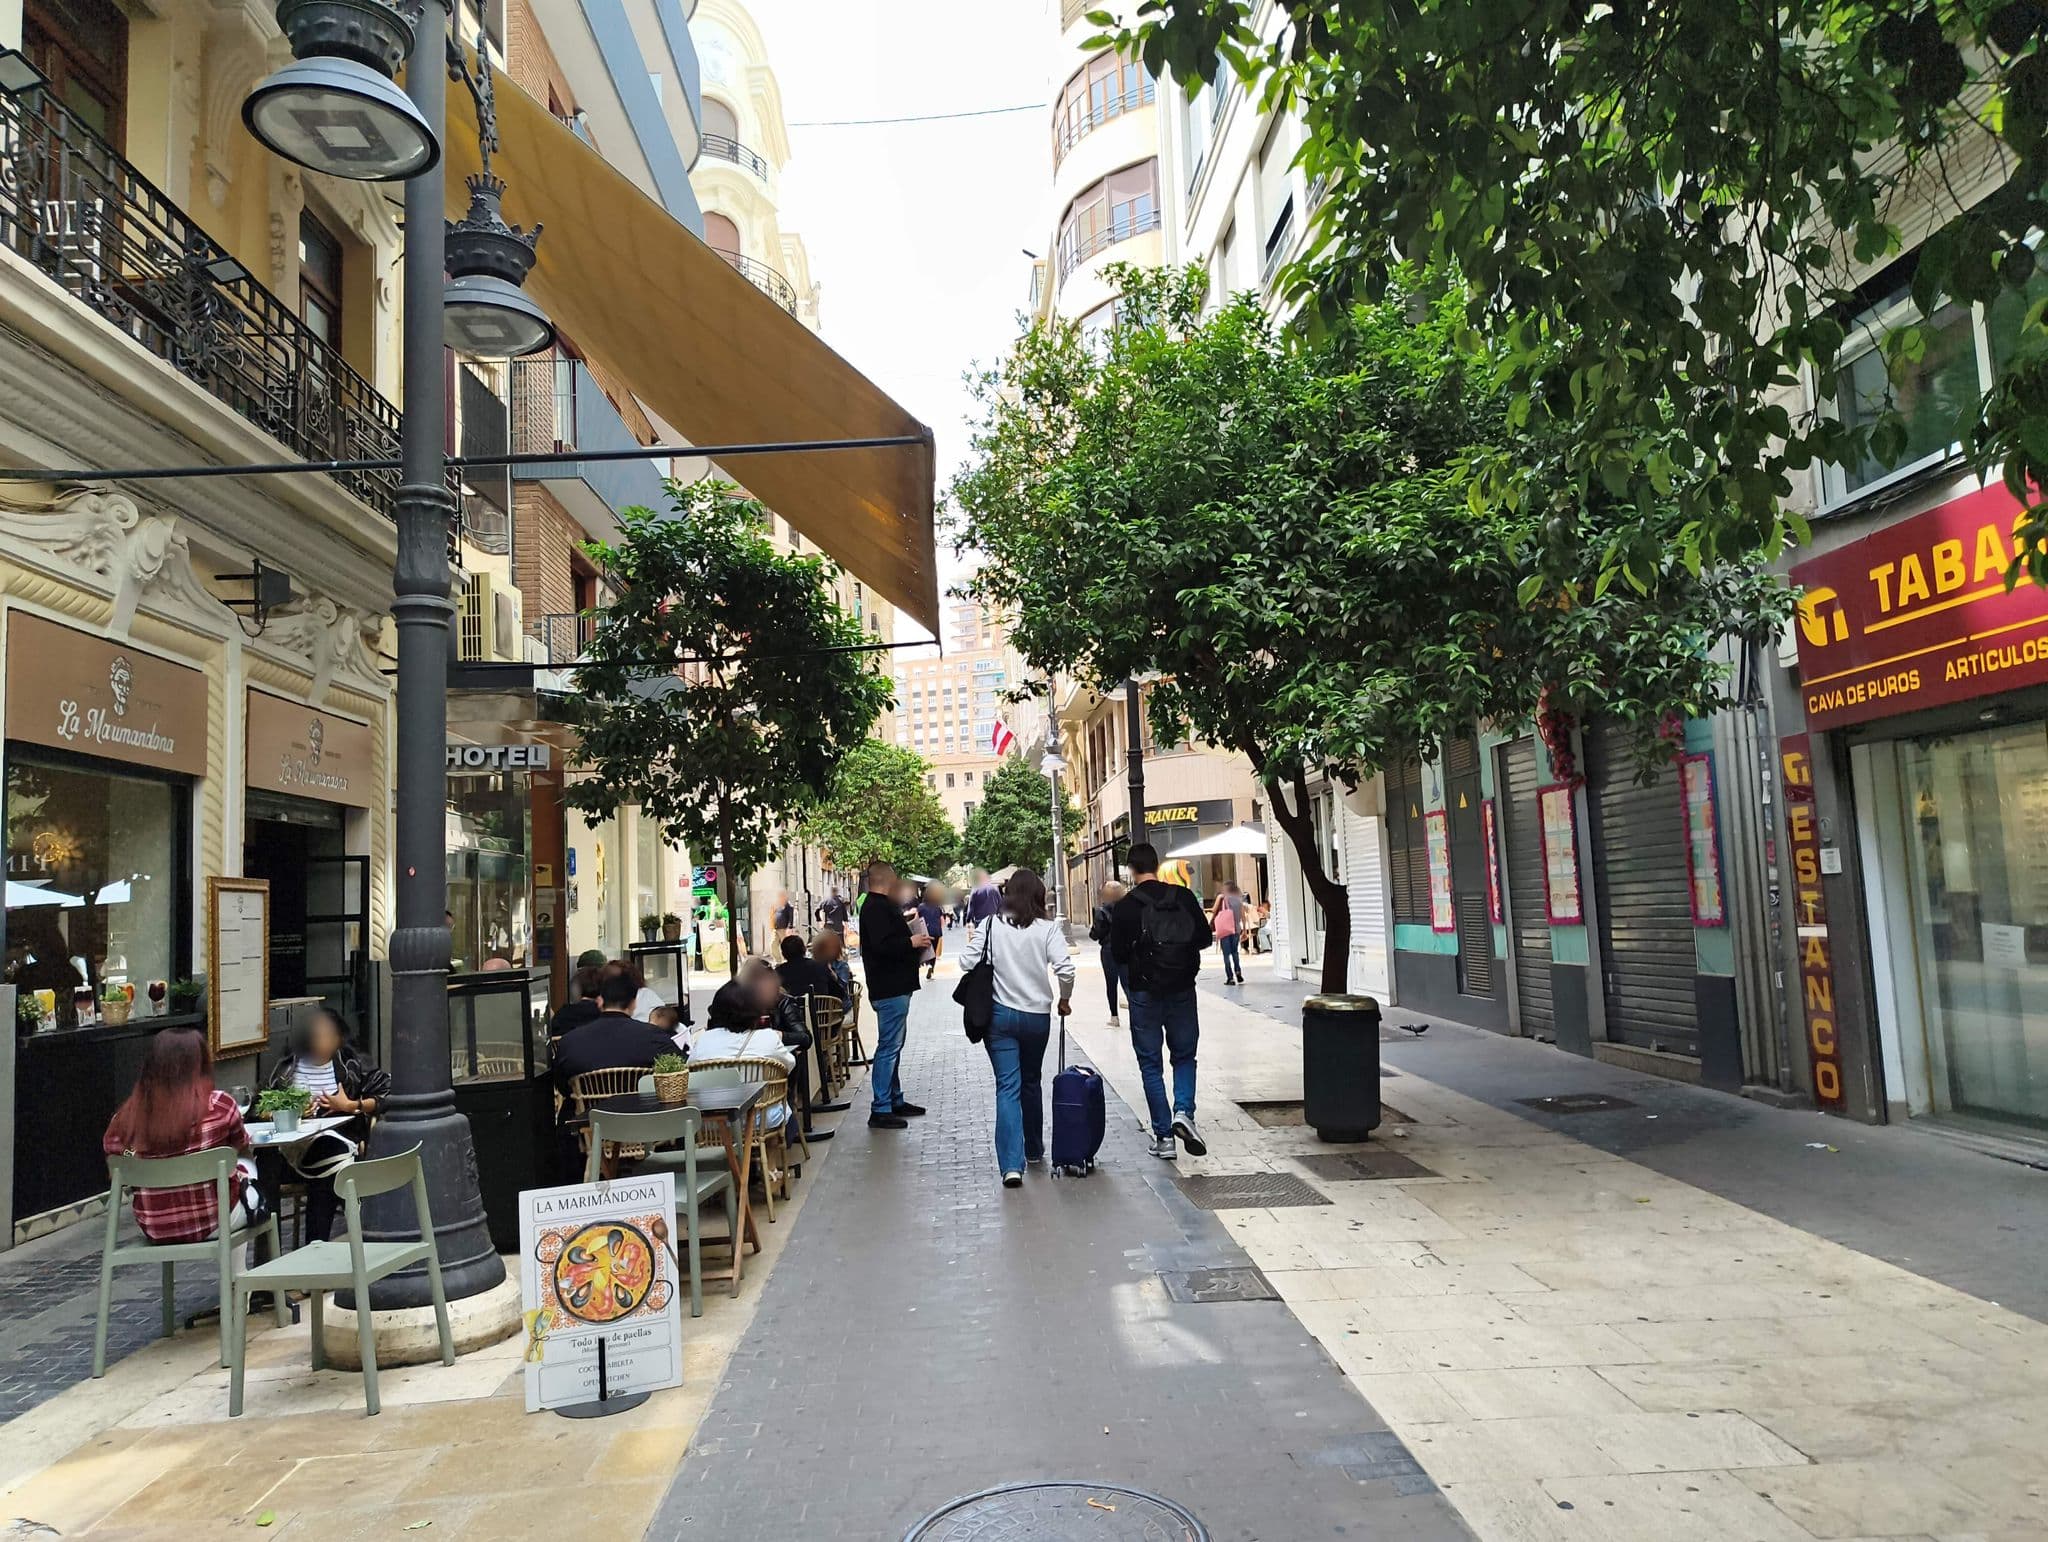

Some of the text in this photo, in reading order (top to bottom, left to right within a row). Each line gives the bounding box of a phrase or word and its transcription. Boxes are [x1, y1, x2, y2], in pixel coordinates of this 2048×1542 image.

[1808, 670, 1920, 714] CAVA DE PUROS
[57, 700, 80, 740] La
[446, 747, 547, 766] HOTEL
[1790, 806, 1840, 1100] ESTANCO
[536, 1187, 657, 1214] LA MARIMANDONA
[571, 1339, 592, 1349] Todo
[612, 1332, 622, 1341] de
[623, 1328, 652, 1341] paellas
